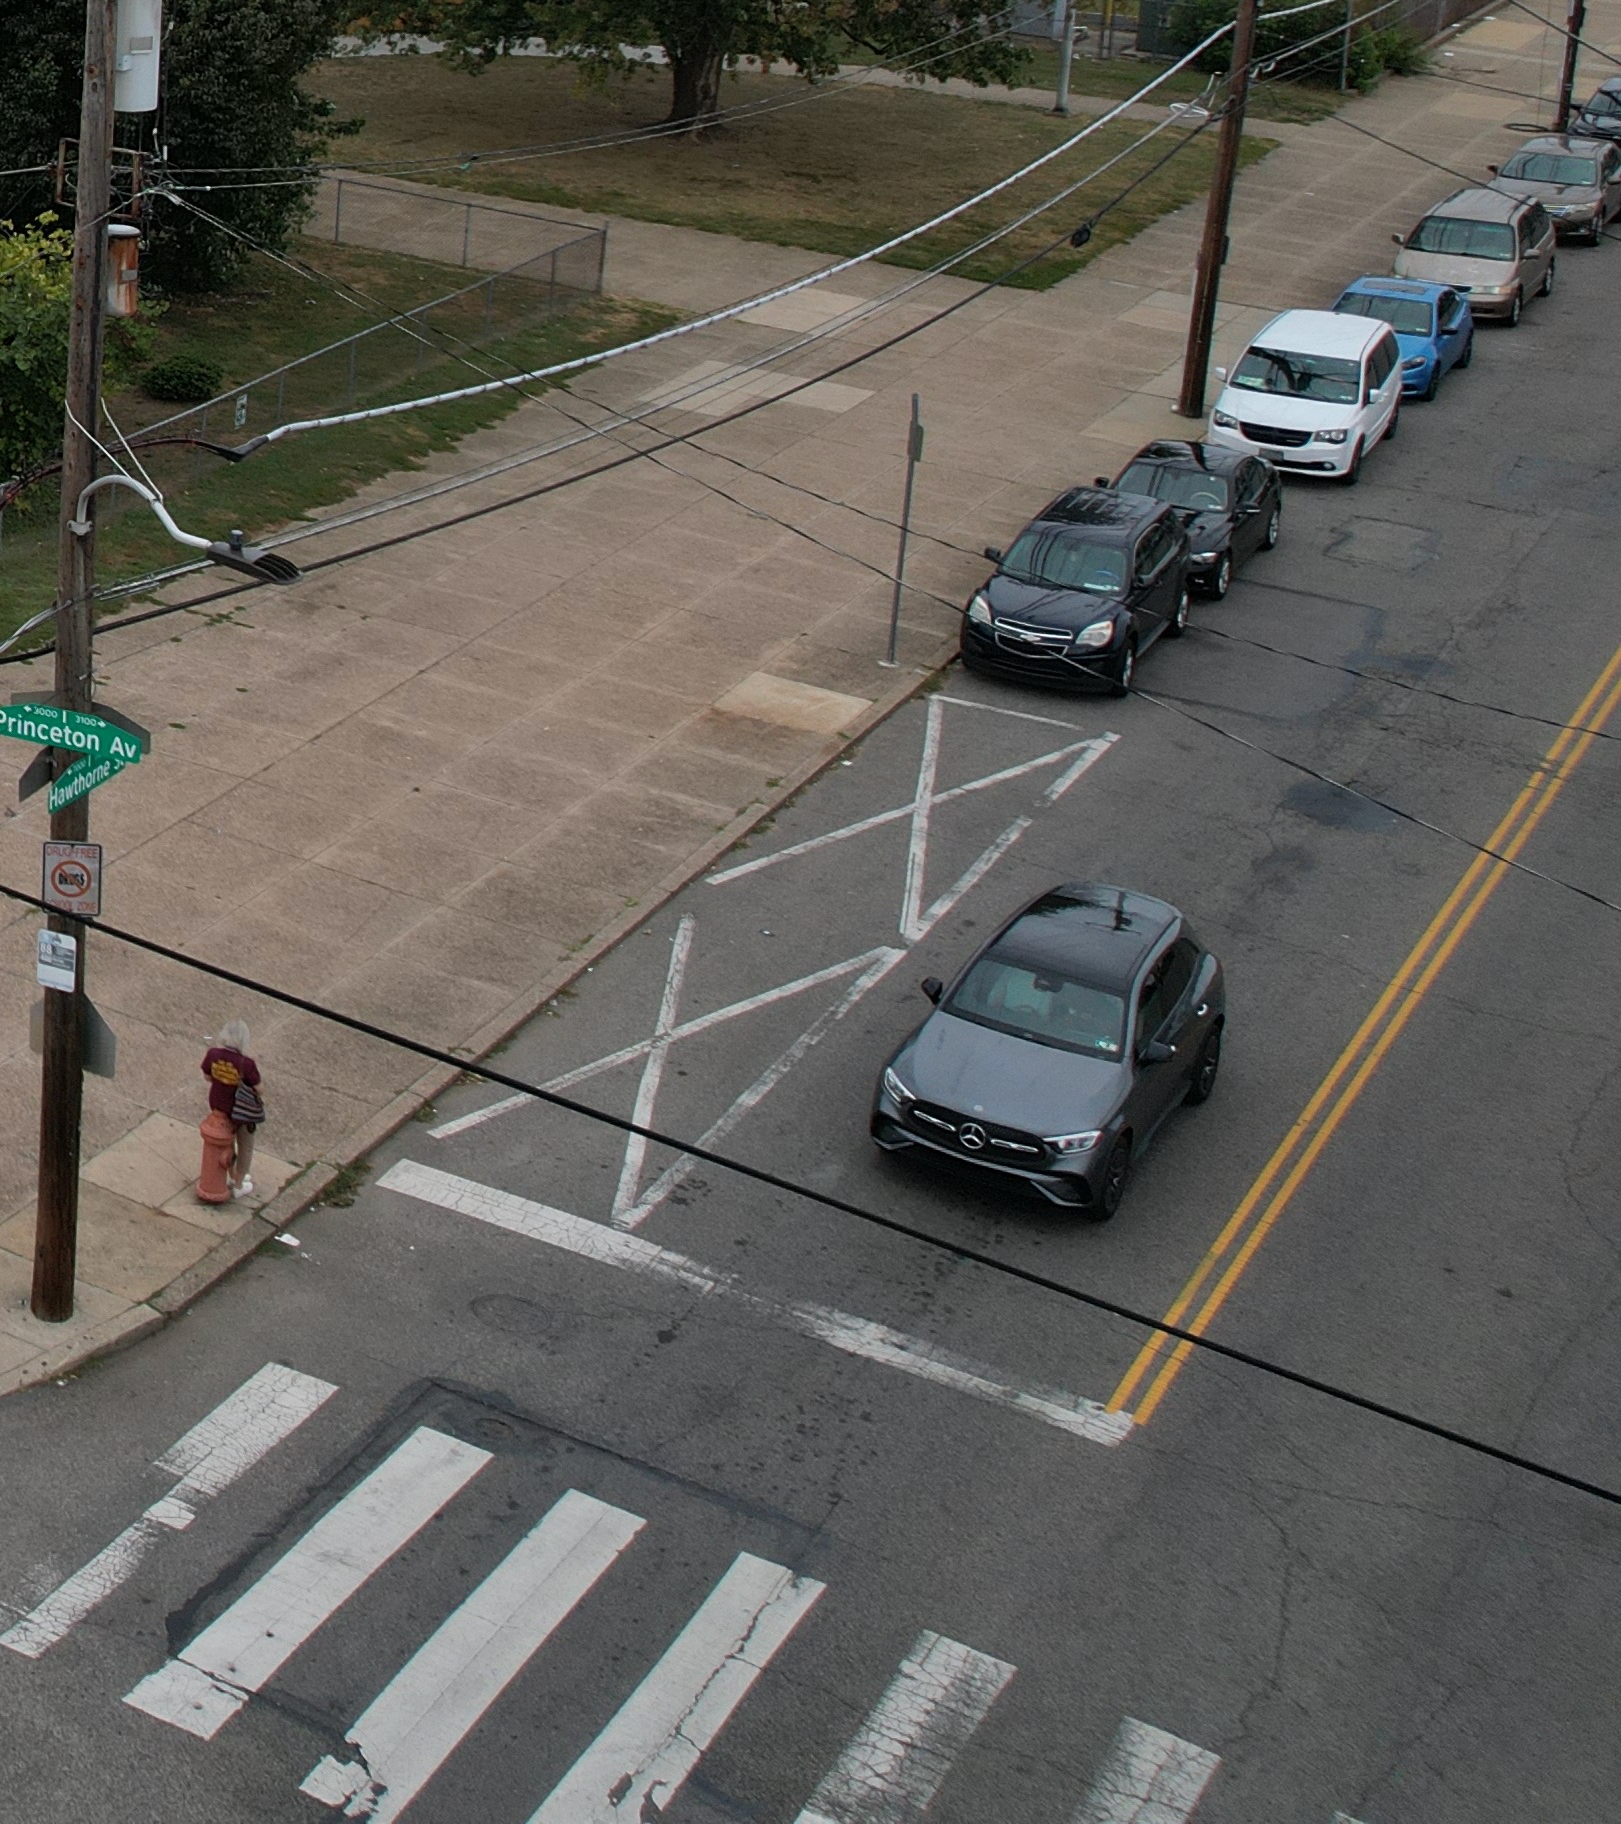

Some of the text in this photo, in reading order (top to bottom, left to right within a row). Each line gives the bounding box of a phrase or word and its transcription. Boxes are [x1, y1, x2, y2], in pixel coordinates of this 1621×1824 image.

[33, 706, 97, 727] 3000 3100
[109, 736, 137, 759] Av
[49, 760, 111, 811] Hawthorne
